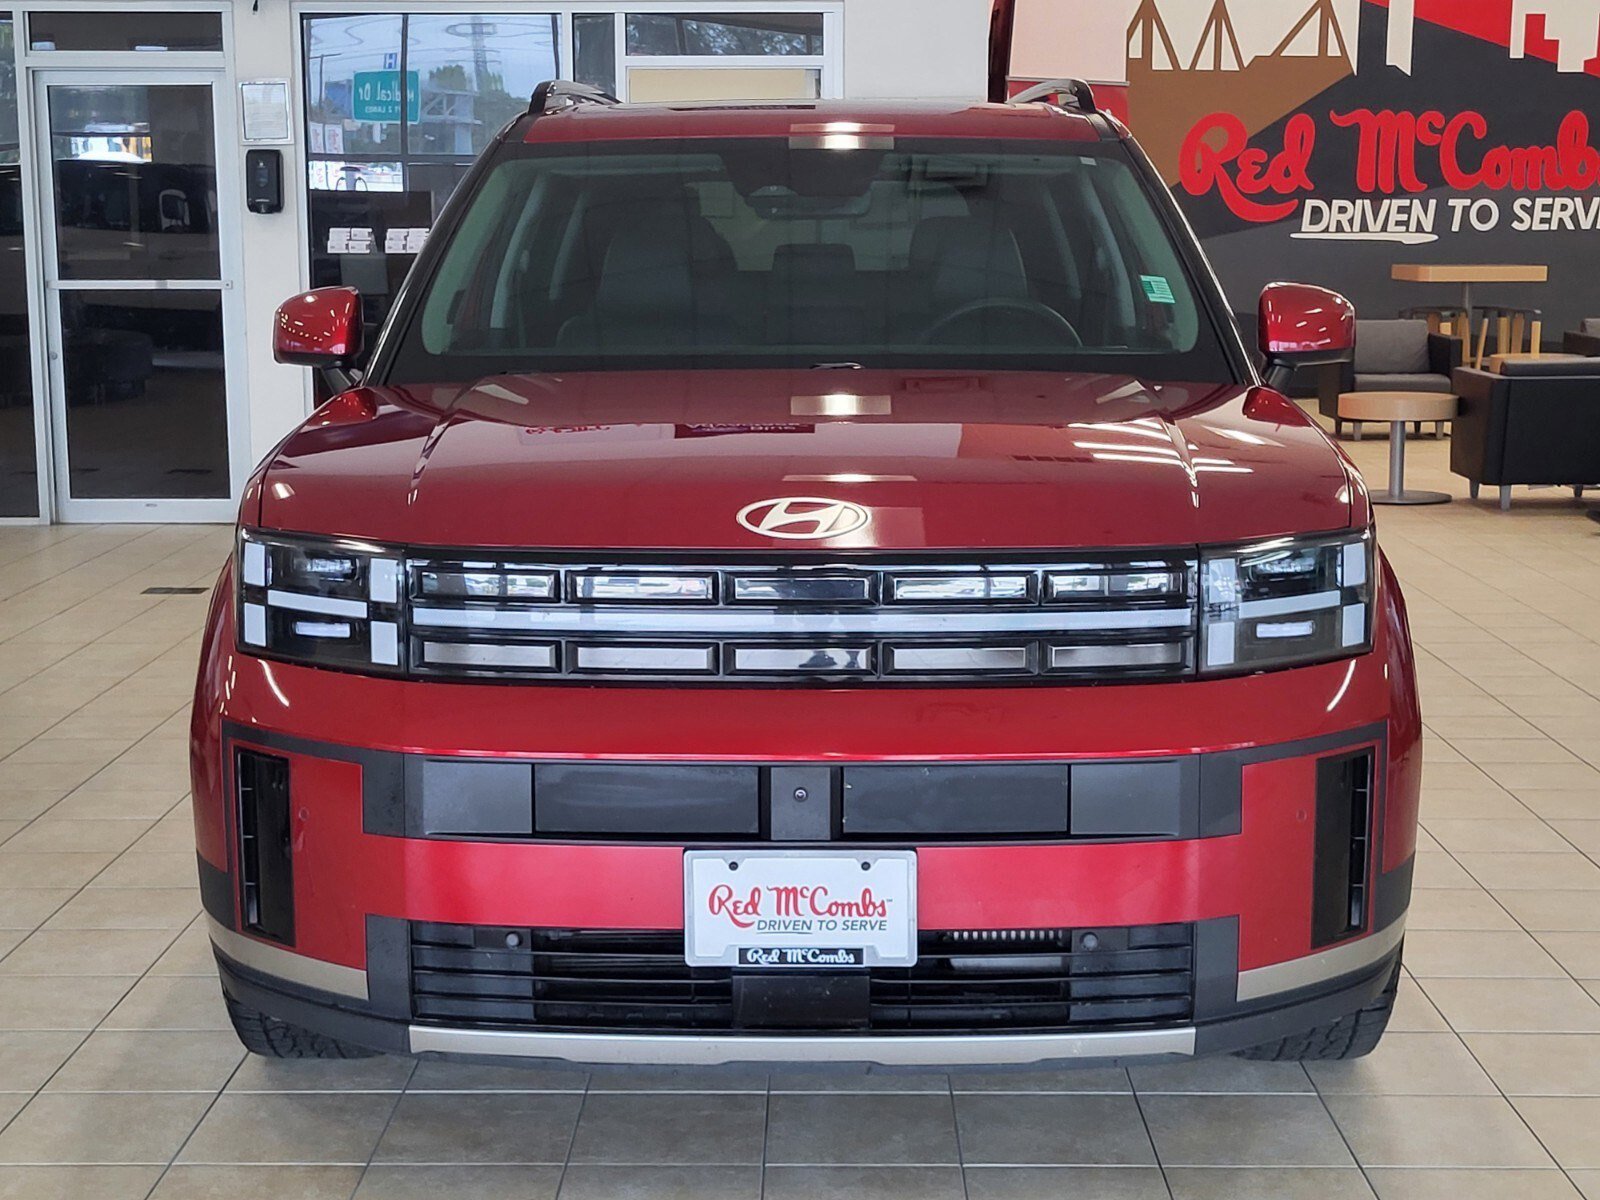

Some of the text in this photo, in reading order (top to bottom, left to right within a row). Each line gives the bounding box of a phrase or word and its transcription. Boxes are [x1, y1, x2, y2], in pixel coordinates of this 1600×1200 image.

[1179, 108, 1600, 222] Red McComb
[1301, 197, 1600, 232] DRIVEN TO SERV
[708, 884, 887, 928] Red McCombs
[757, 919, 887, 931] DRIVEN TO SERVE
[747, 948, 855, 965] Red McCombs
